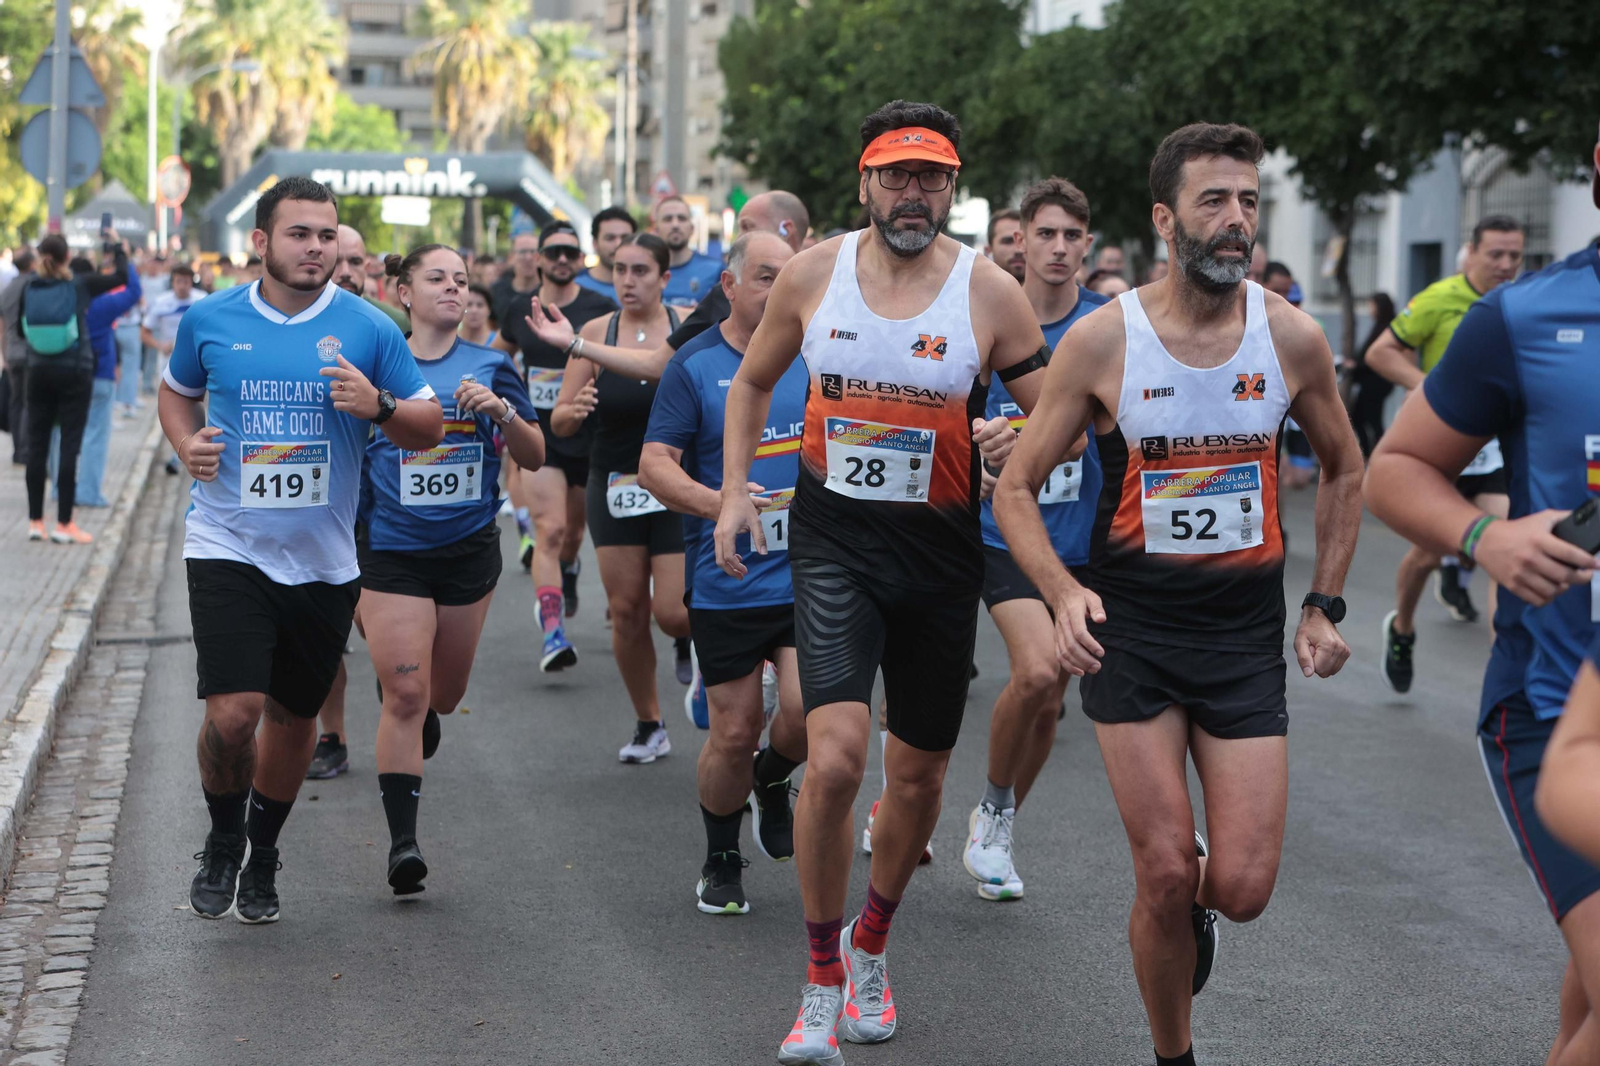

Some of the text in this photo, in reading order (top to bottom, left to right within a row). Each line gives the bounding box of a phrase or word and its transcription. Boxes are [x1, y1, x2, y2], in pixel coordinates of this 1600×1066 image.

[240, 380, 325, 403] AMERICAN'S
[847, 379, 948, 402] RUBYSAN
[847, 391, 872, 399] industria
[242, 411, 285, 435] GAME
[840, 425, 877, 437] RRERA
[878, 441, 903, 449] SANTO
[905, 444, 928, 452] ANGEL
[1172, 432, 1271, 449] RUBYSAN
[407, 449, 476, 458] CARRERA POPULAR
[1173, 447, 1200, 456] industria
[845, 456, 886, 488] 28
[1152, 472, 1251, 488] CARRERA POPULAR
[249, 473, 304, 498] 419
[410, 473, 459, 496] 369
[1204, 485, 1230, 494] SANTO
[1232, 482, 1256, 490] ANGEL
[613, 492, 650, 509] 432
[1171, 508, 1219, 540] 52
